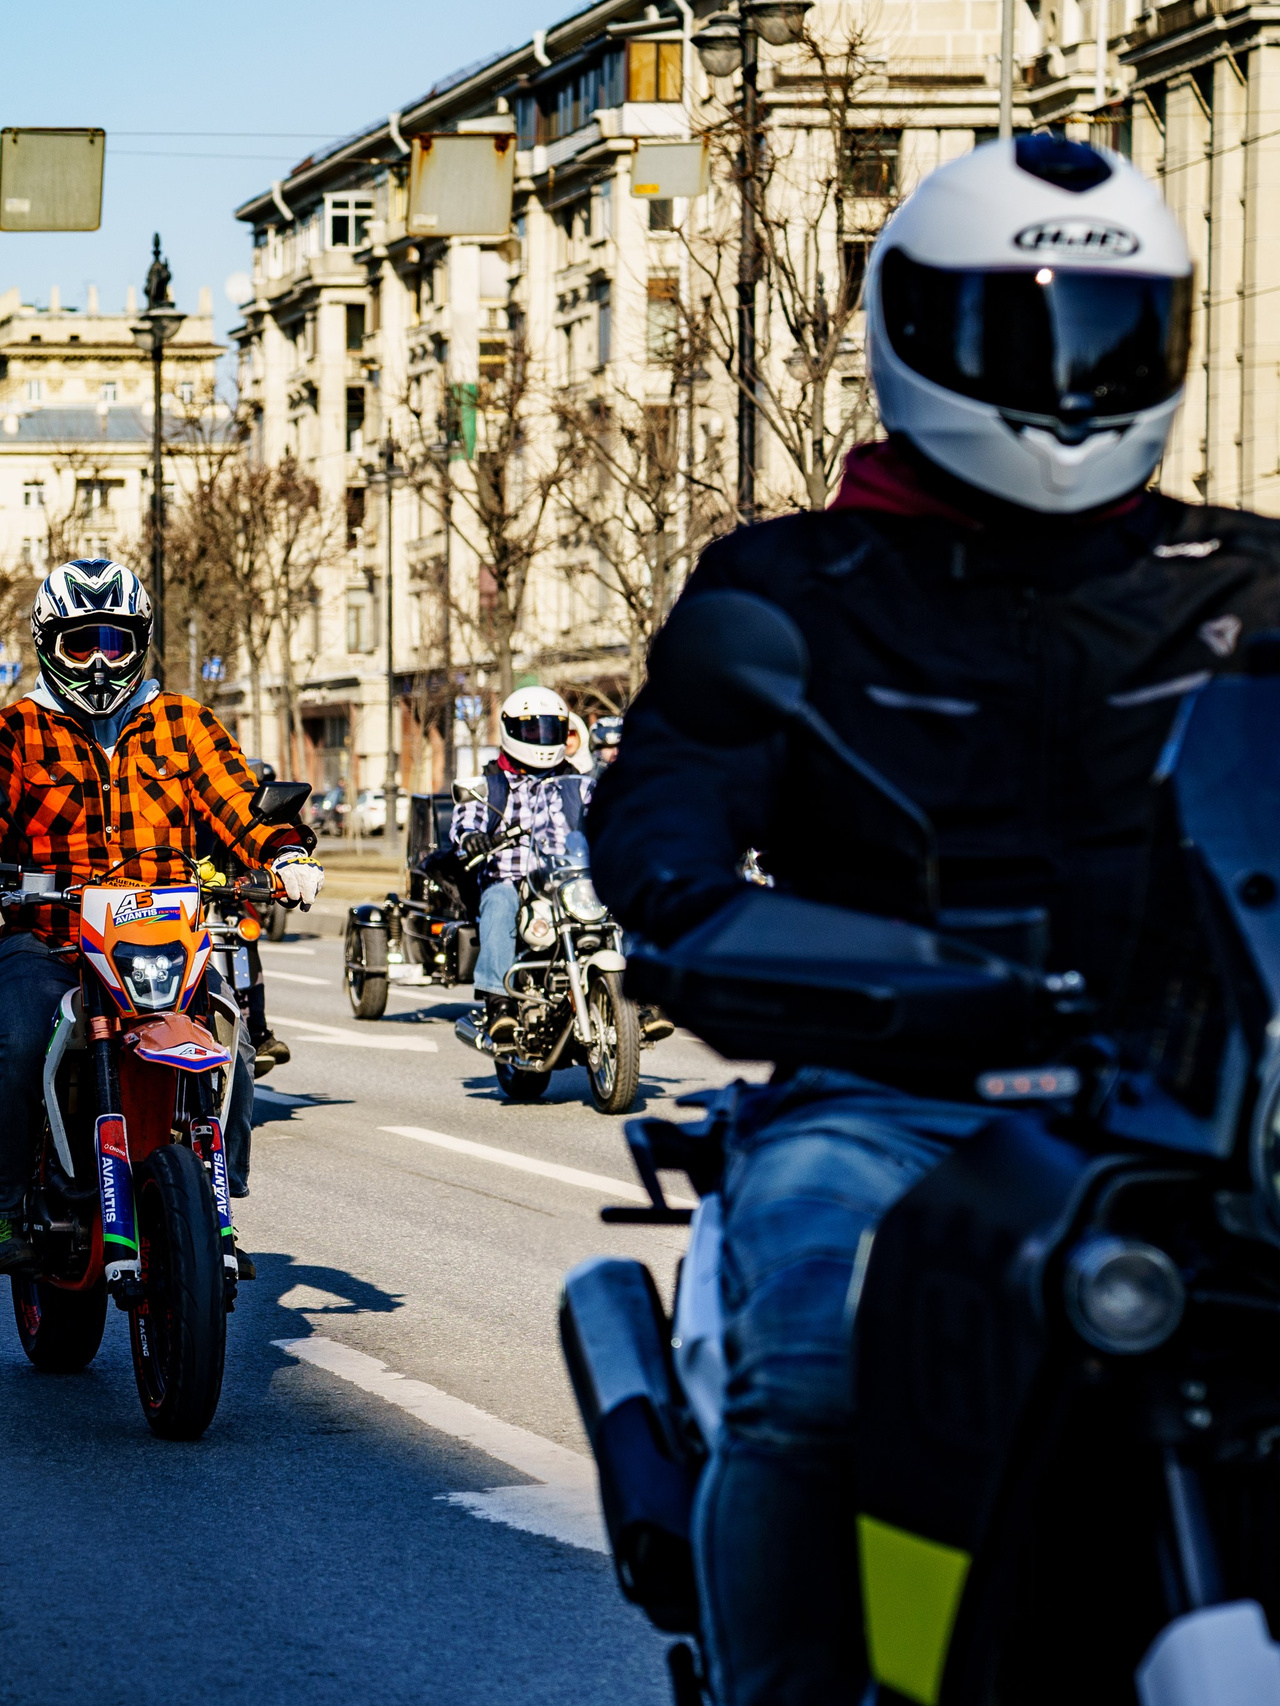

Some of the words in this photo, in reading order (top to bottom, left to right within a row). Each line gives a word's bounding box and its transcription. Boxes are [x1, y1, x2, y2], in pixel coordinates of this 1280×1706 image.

[115, 890, 154, 915] A5
[115, 909, 158, 925] AVANTIS
[102, 1157, 116, 1223] AVANTIS
[213, 1152, 228, 1216] AVANTIS
[138, 1318, 150, 1357] RACING
